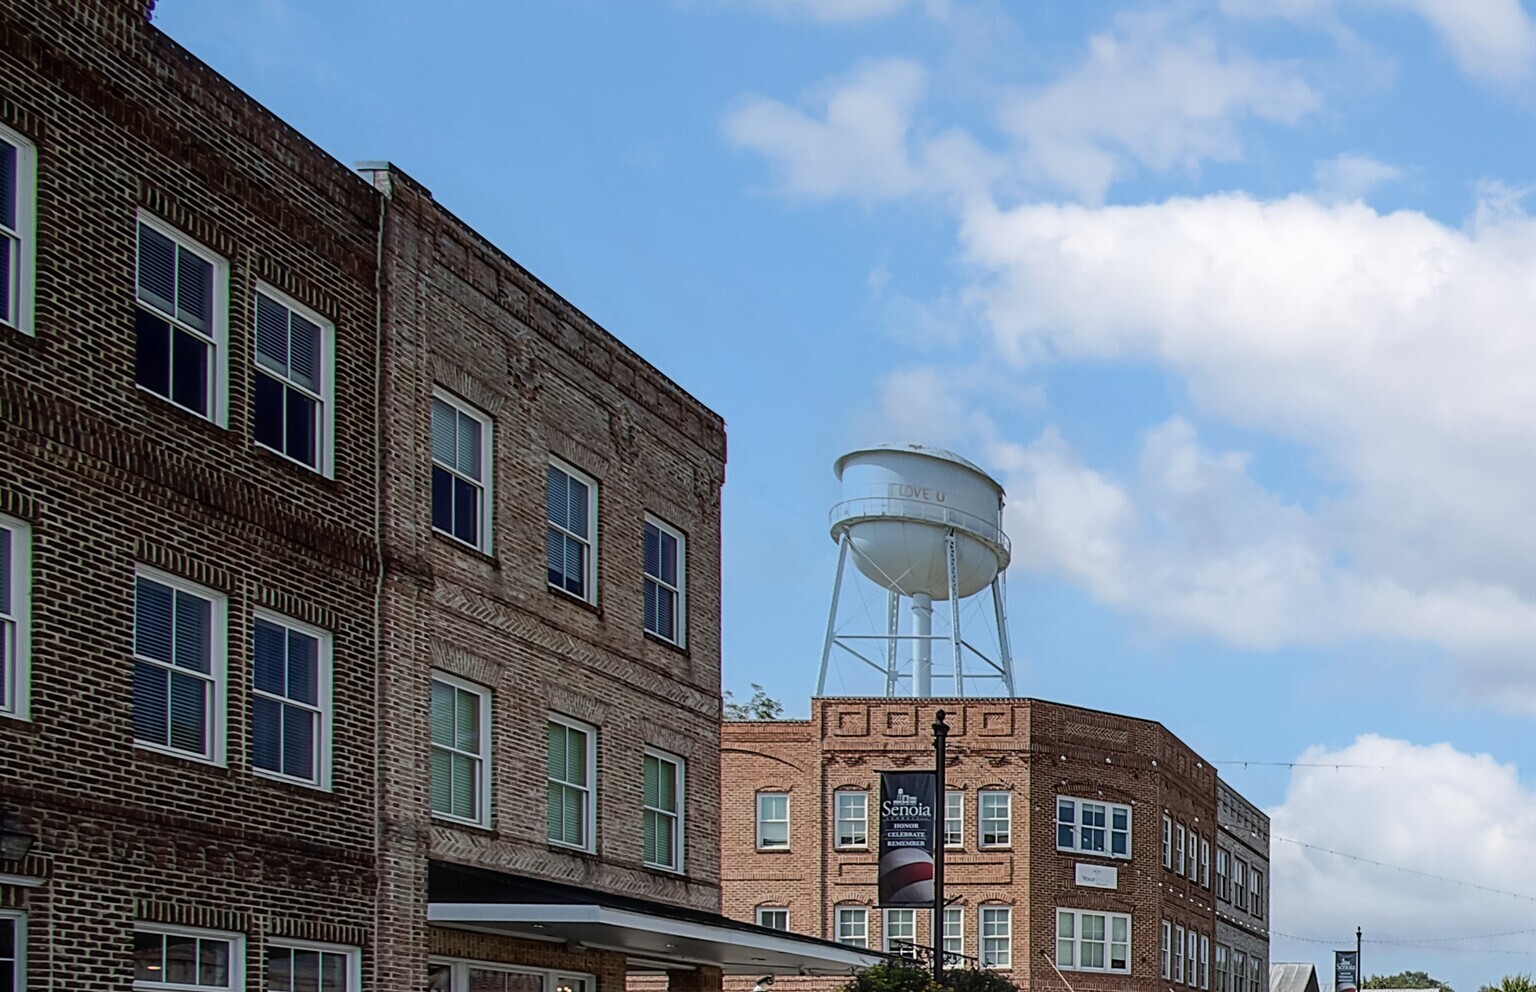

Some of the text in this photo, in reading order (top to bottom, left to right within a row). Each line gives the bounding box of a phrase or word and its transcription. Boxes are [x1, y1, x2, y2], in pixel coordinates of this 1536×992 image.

[899, 484, 929, 500] LOVE
[936, 490, 945, 503] U
[882, 800, 931, 817] Senoia
